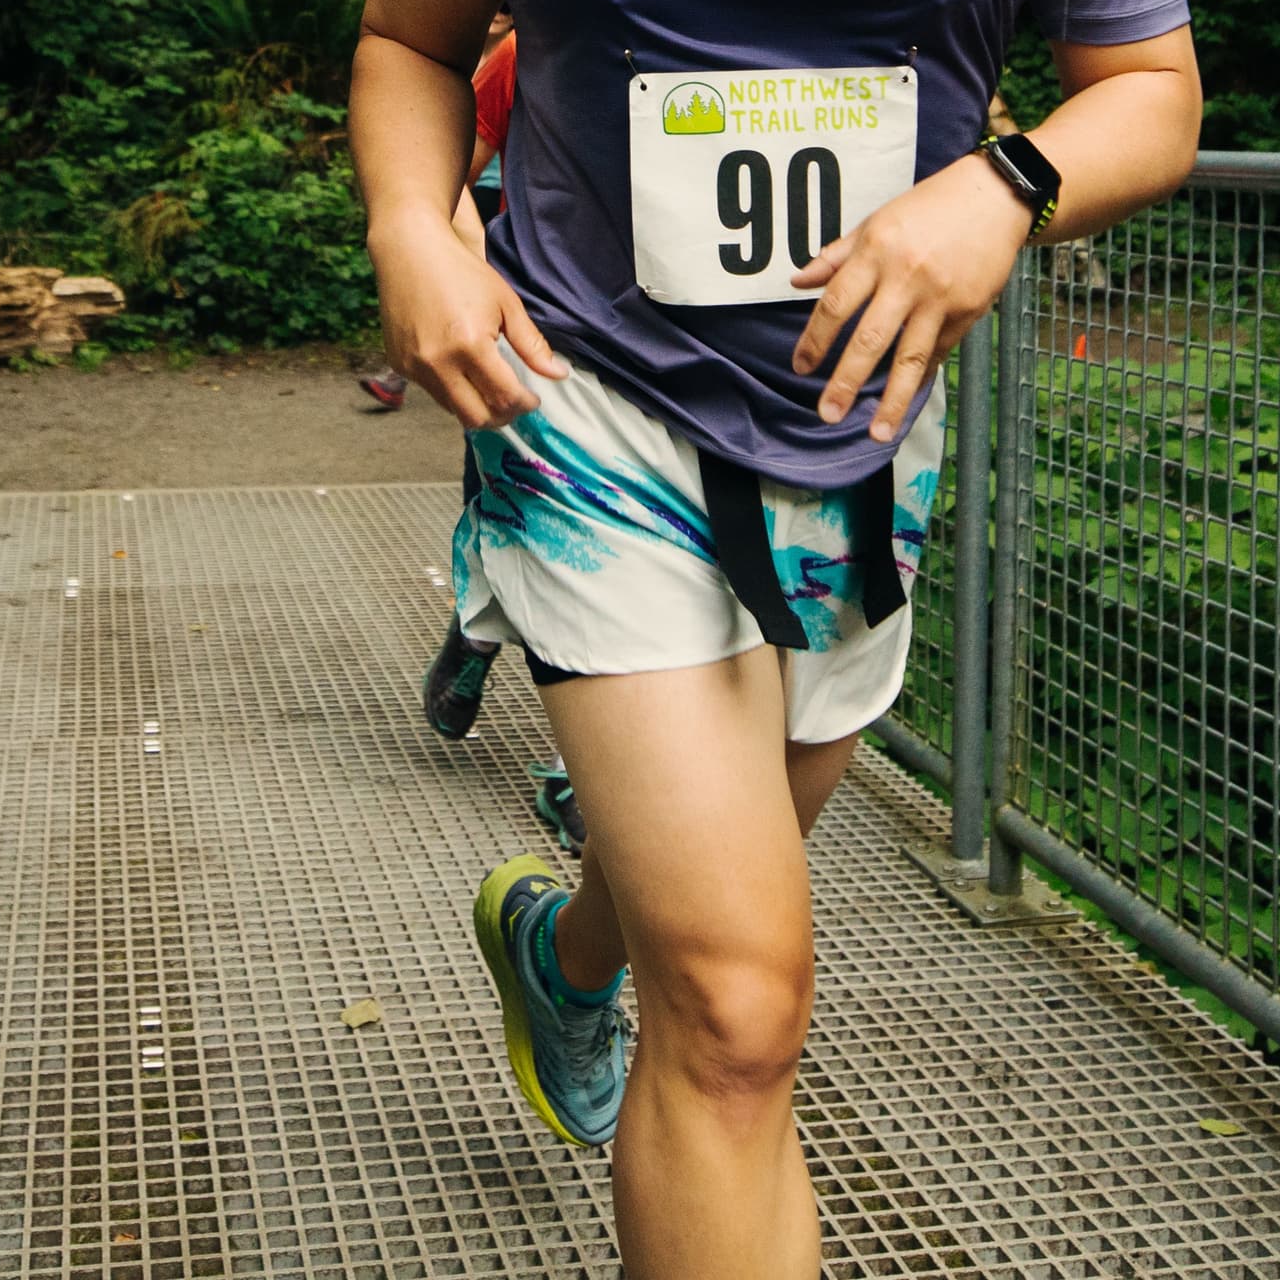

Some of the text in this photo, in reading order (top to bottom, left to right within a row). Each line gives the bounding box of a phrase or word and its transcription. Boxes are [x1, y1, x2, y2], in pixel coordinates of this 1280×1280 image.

[729, 76, 891, 104] NORTHWEST
[730, 105, 879, 133] TRAIL RUNS
[717, 147, 841, 275] 90
